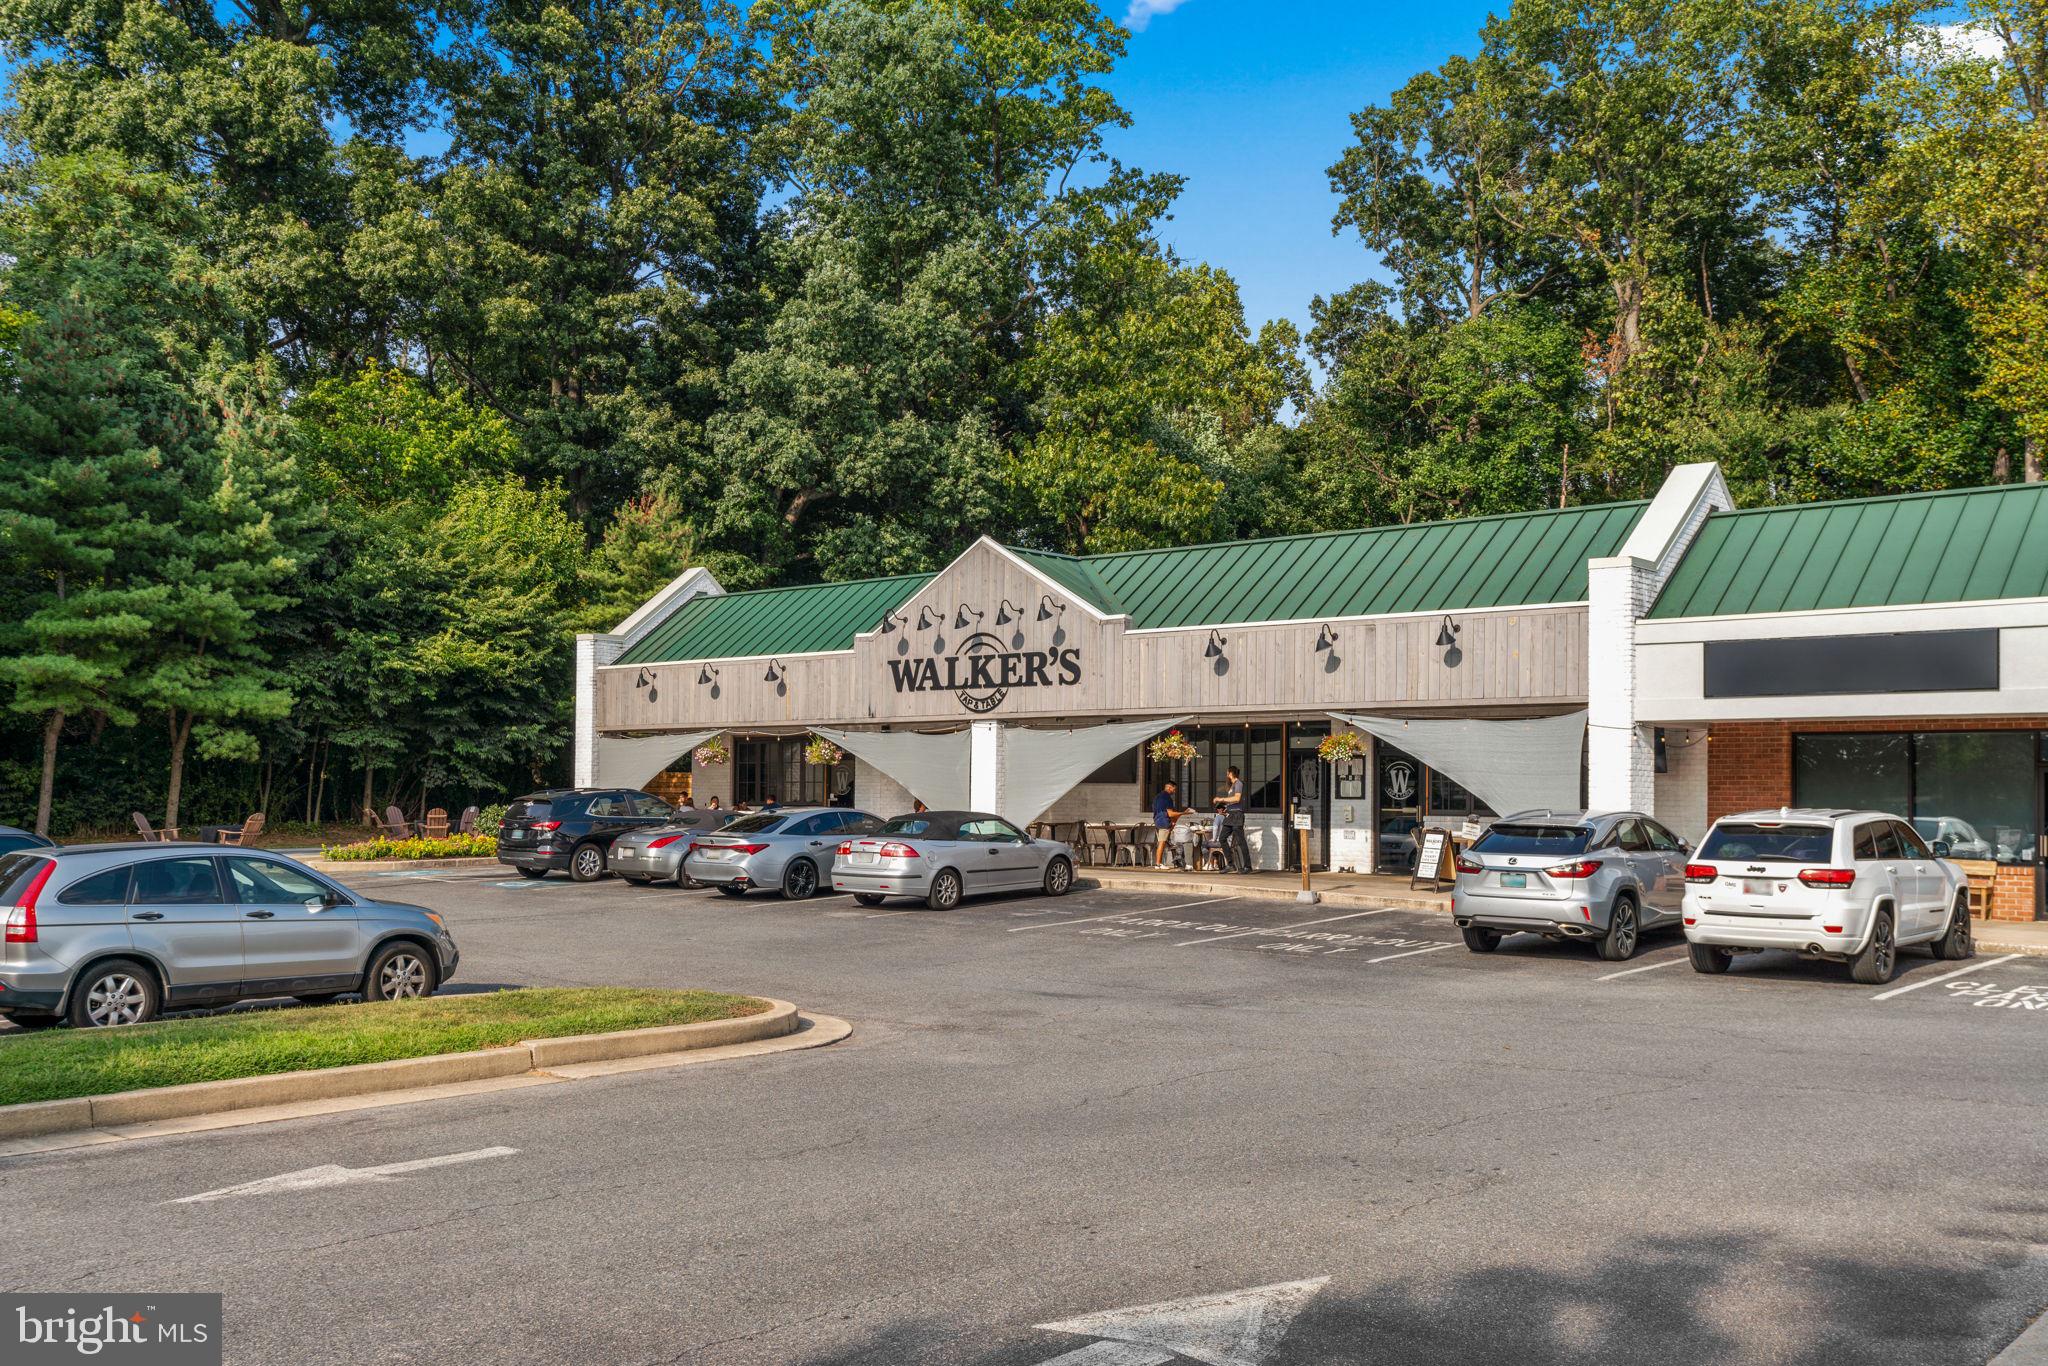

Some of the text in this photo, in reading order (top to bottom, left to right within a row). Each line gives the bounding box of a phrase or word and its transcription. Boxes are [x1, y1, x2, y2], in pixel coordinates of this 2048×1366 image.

[887, 646, 1082, 693] WALKER'S
[959, 688, 1005, 710] TAP & TABLE
[1390, 769, 1411, 793] W
[1746, 865, 1766, 873] Jeep
[1373, 938, 1453, 948] OUT
